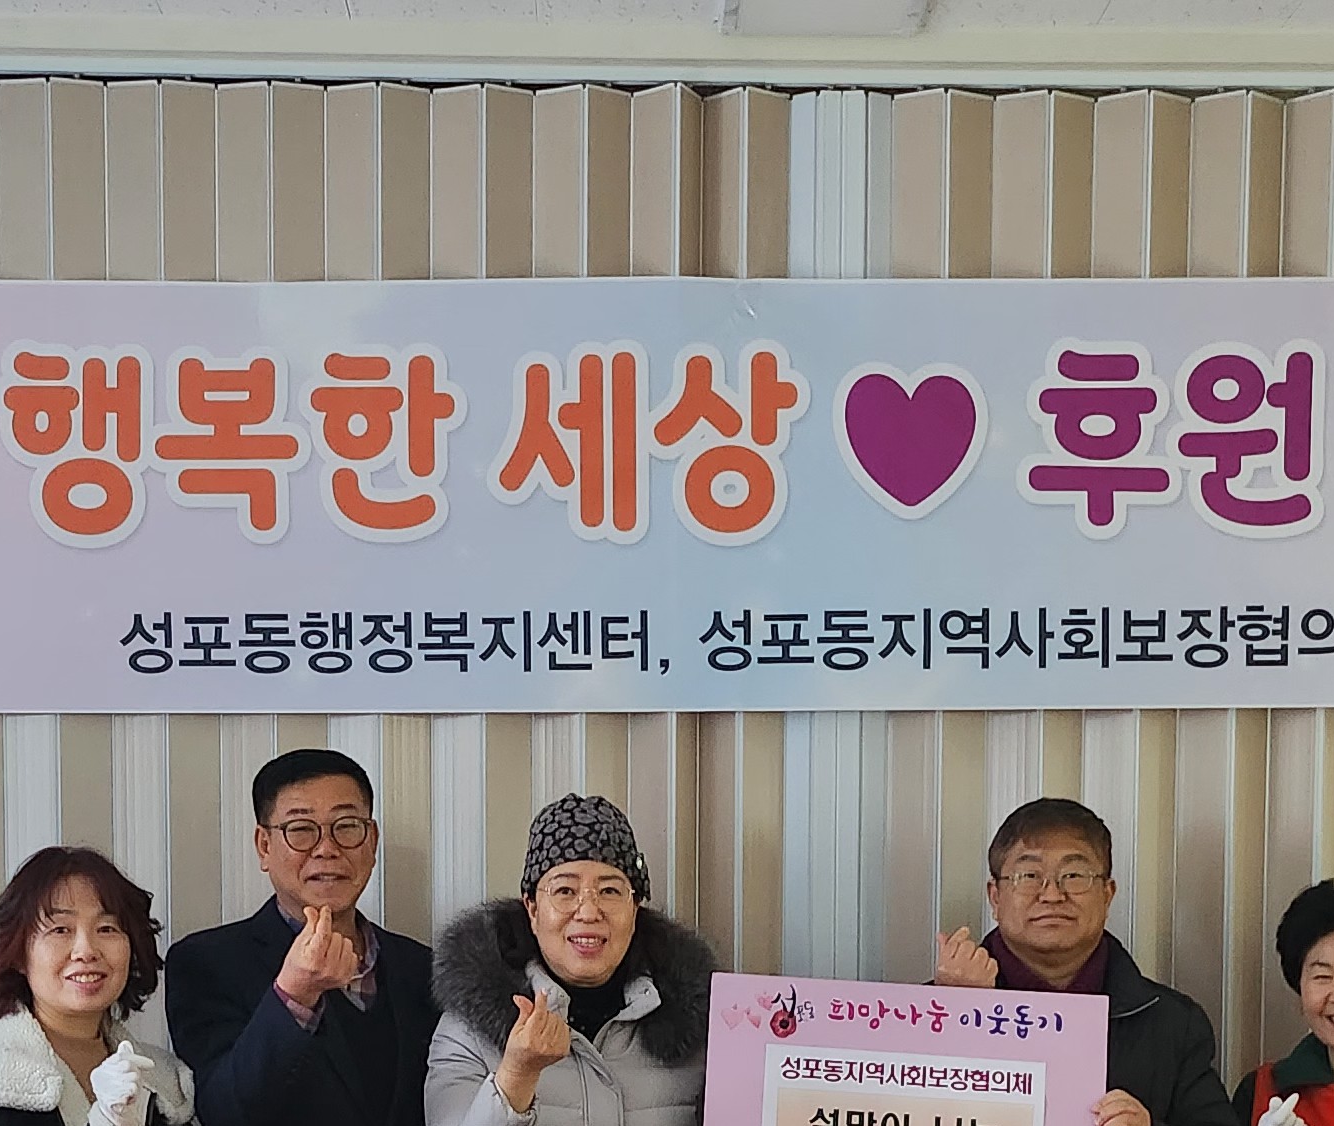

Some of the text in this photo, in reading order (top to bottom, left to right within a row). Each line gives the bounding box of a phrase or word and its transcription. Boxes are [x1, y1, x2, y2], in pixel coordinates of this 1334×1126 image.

[2, 350, 457, 535] 행복한
[497, 350, 799, 535] 세상
[1027, 350, 1313, 528] 후원
[118, 608, 671, 678] 성포동행정복지센터,
[828, 999, 949, 1032] 희망나눔
[959, 1004, 1063, 1038] 이웃돕기
[781, 1056, 1033, 1094] 성포동지역사회보장협의체
